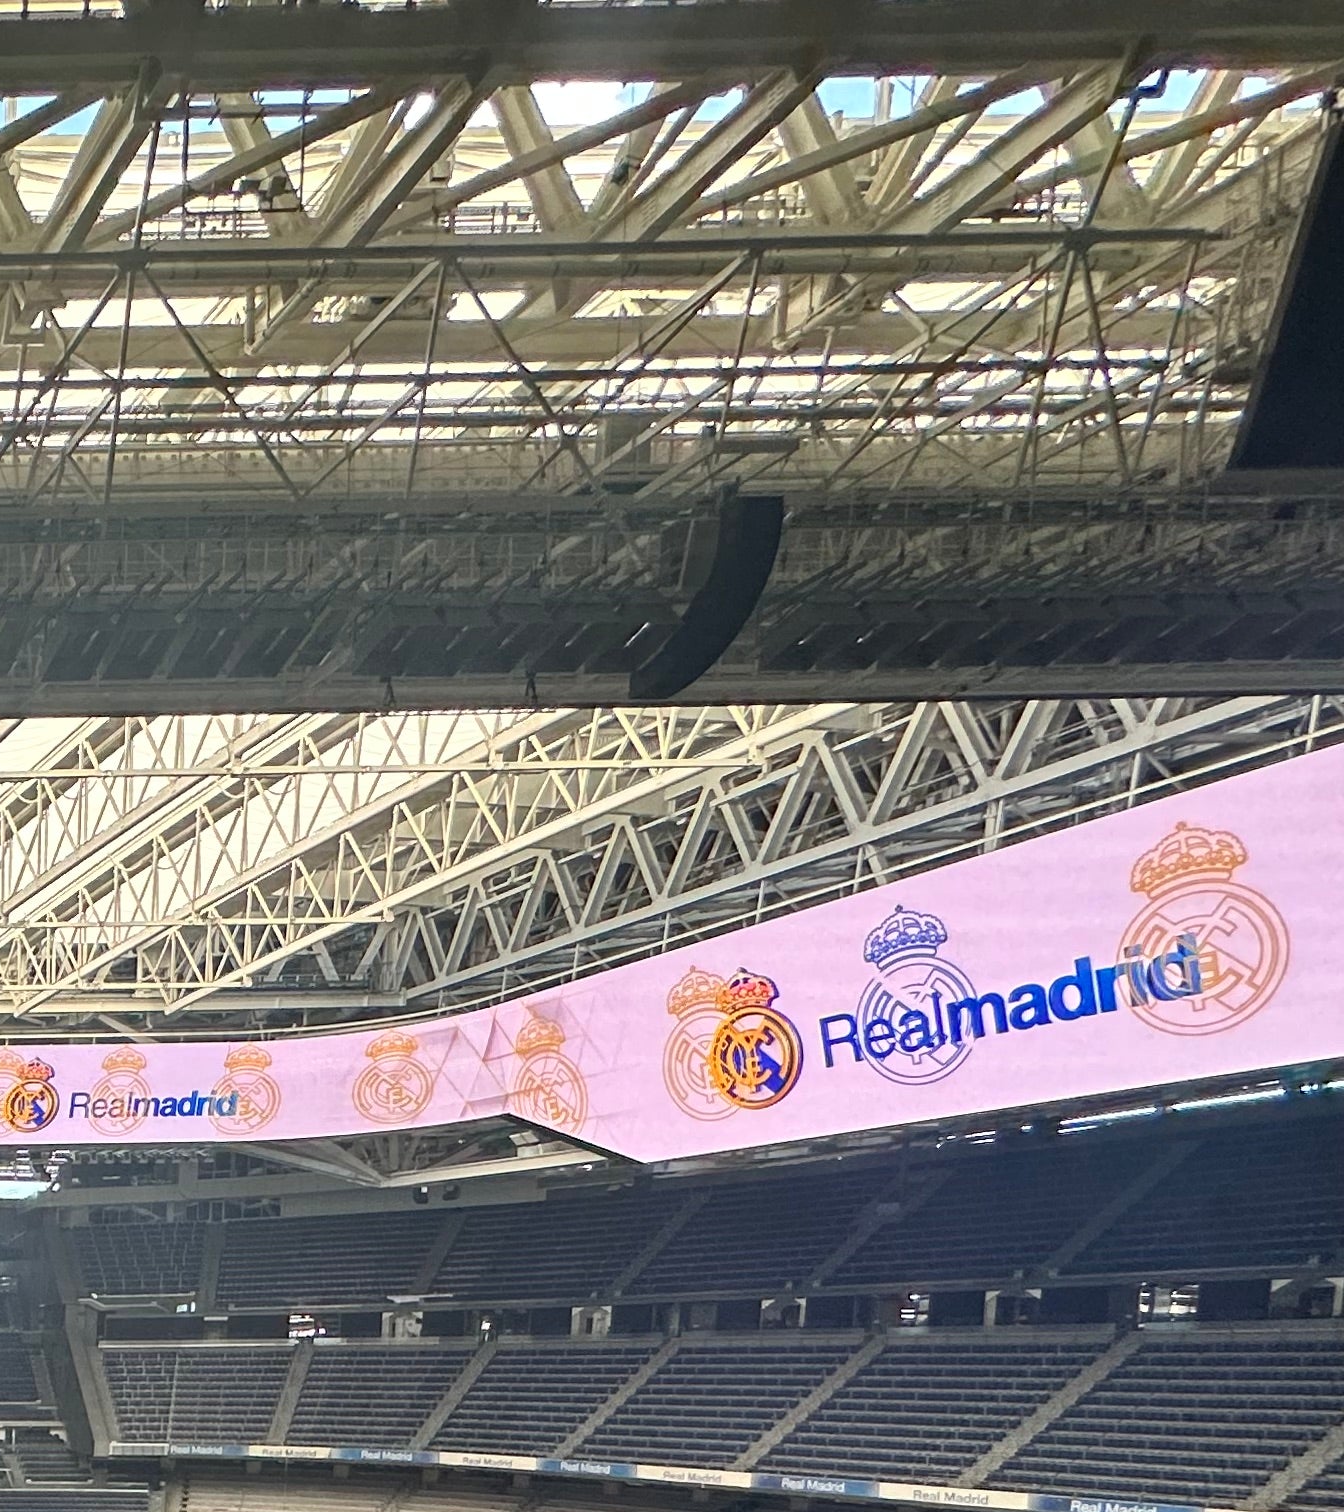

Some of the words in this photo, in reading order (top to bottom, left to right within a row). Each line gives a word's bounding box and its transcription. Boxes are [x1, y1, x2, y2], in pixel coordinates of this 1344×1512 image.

[362, 1451, 380, 1460] Real
[382, 1452, 412, 1462] Madrid
[462, 1457, 481, 1466] Real
[483, 1458, 512, 1467] Madrid
[560, 1461, 578, 1472] Real
[581, 1463, 610, 1475] Madrid
[663, 1471, 684, 1482] Real
[687, 1473, 722, 1484] Madrid
[781, 1477, 804, 1490] Real
[806, 1479, 845, 1493] Madrid
[912, 1490, 940, 1502] Real
[944, 1491, 989, 1507] Madrid
